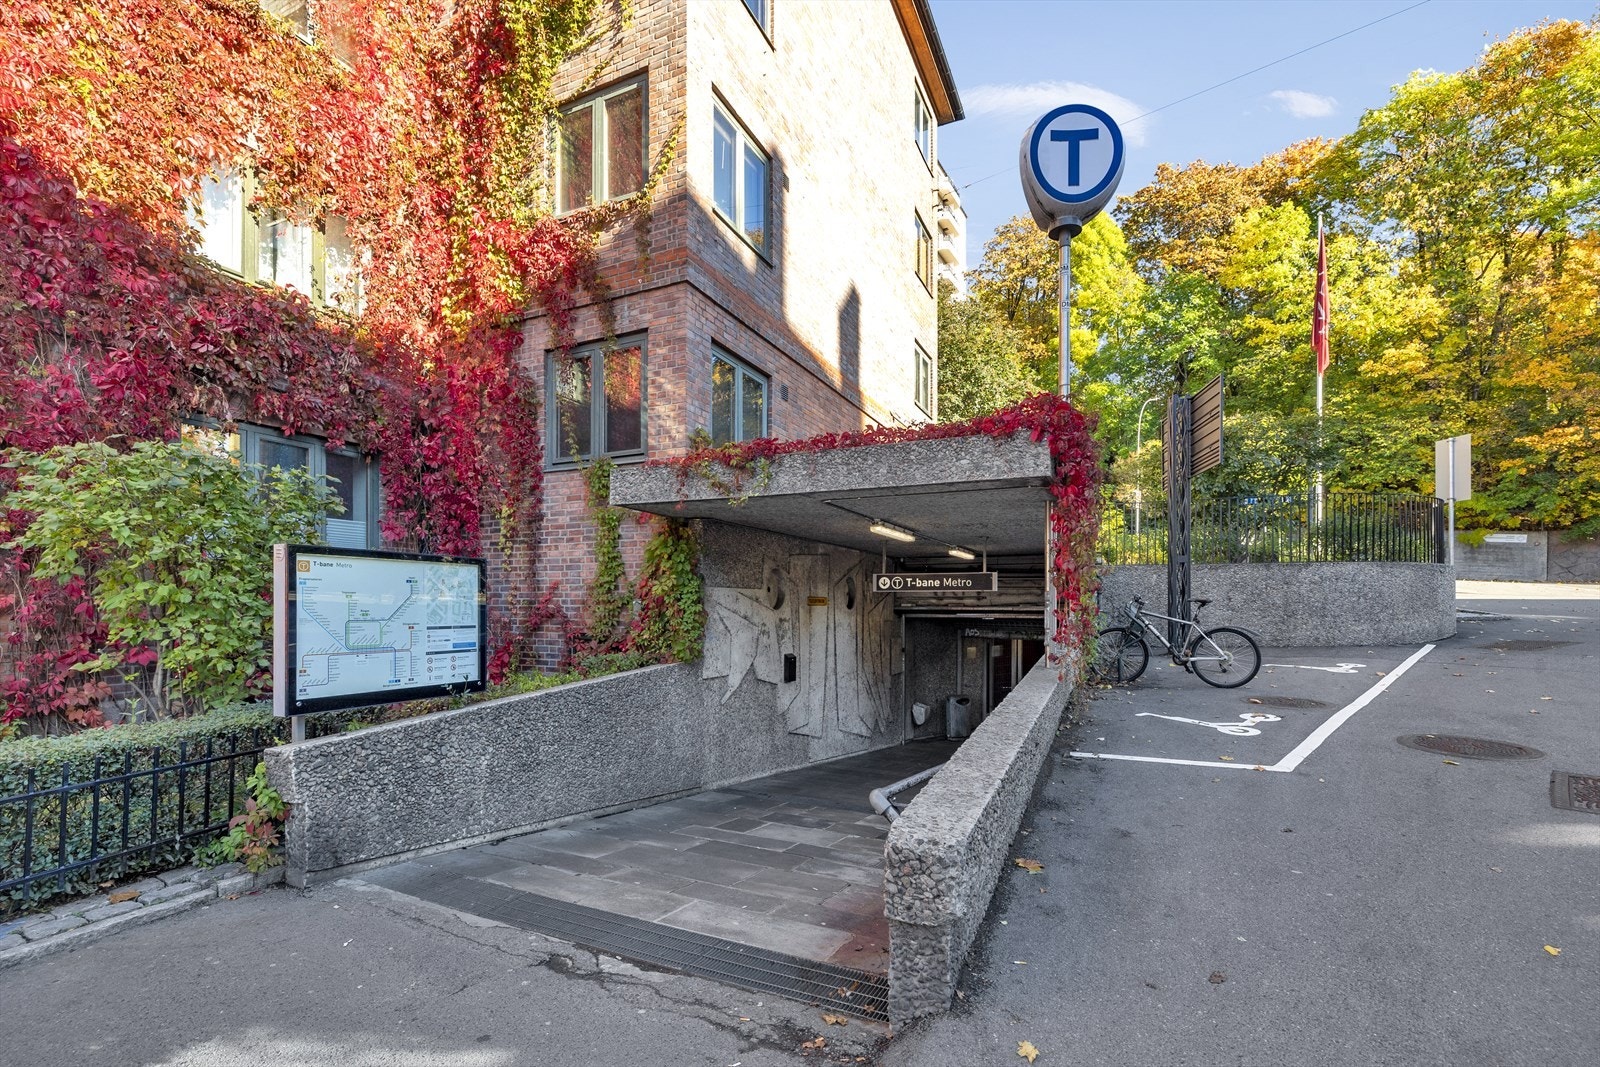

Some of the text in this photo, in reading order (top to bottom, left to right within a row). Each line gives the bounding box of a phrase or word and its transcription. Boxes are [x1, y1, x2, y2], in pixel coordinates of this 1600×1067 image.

[1050, 128, 1099, 186] T
[313, 560, 333, 568] T-bane
[906, 578, 940, 587] T-bane
[943, 577, 972, 587] Metro
